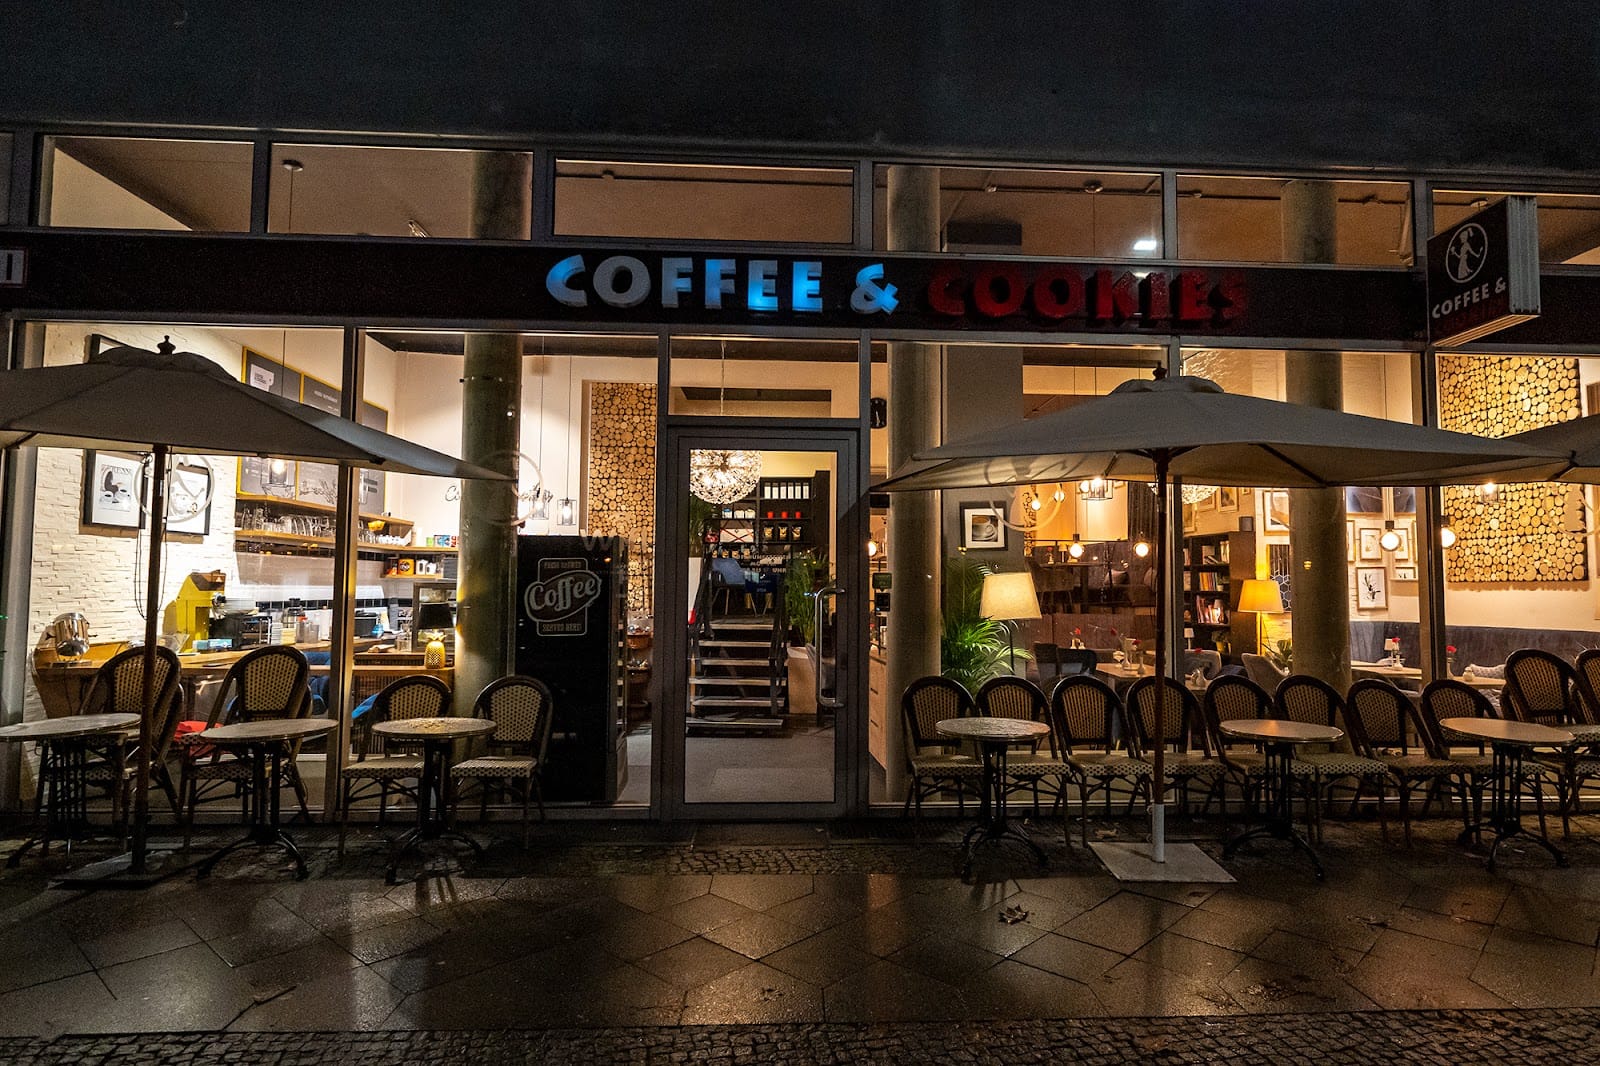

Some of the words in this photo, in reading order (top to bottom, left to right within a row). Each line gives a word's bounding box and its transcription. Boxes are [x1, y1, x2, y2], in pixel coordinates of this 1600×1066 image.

[546, 254, 823, 313] COFFEE
[850, 263, 900, 316] &
[926, 266, 1248, 325] COOKIES
[1432, 283, 1490, 319] COFFEE
[1494, 277, 1507, 294] &
[529, 577, 596, 612] Coffee
